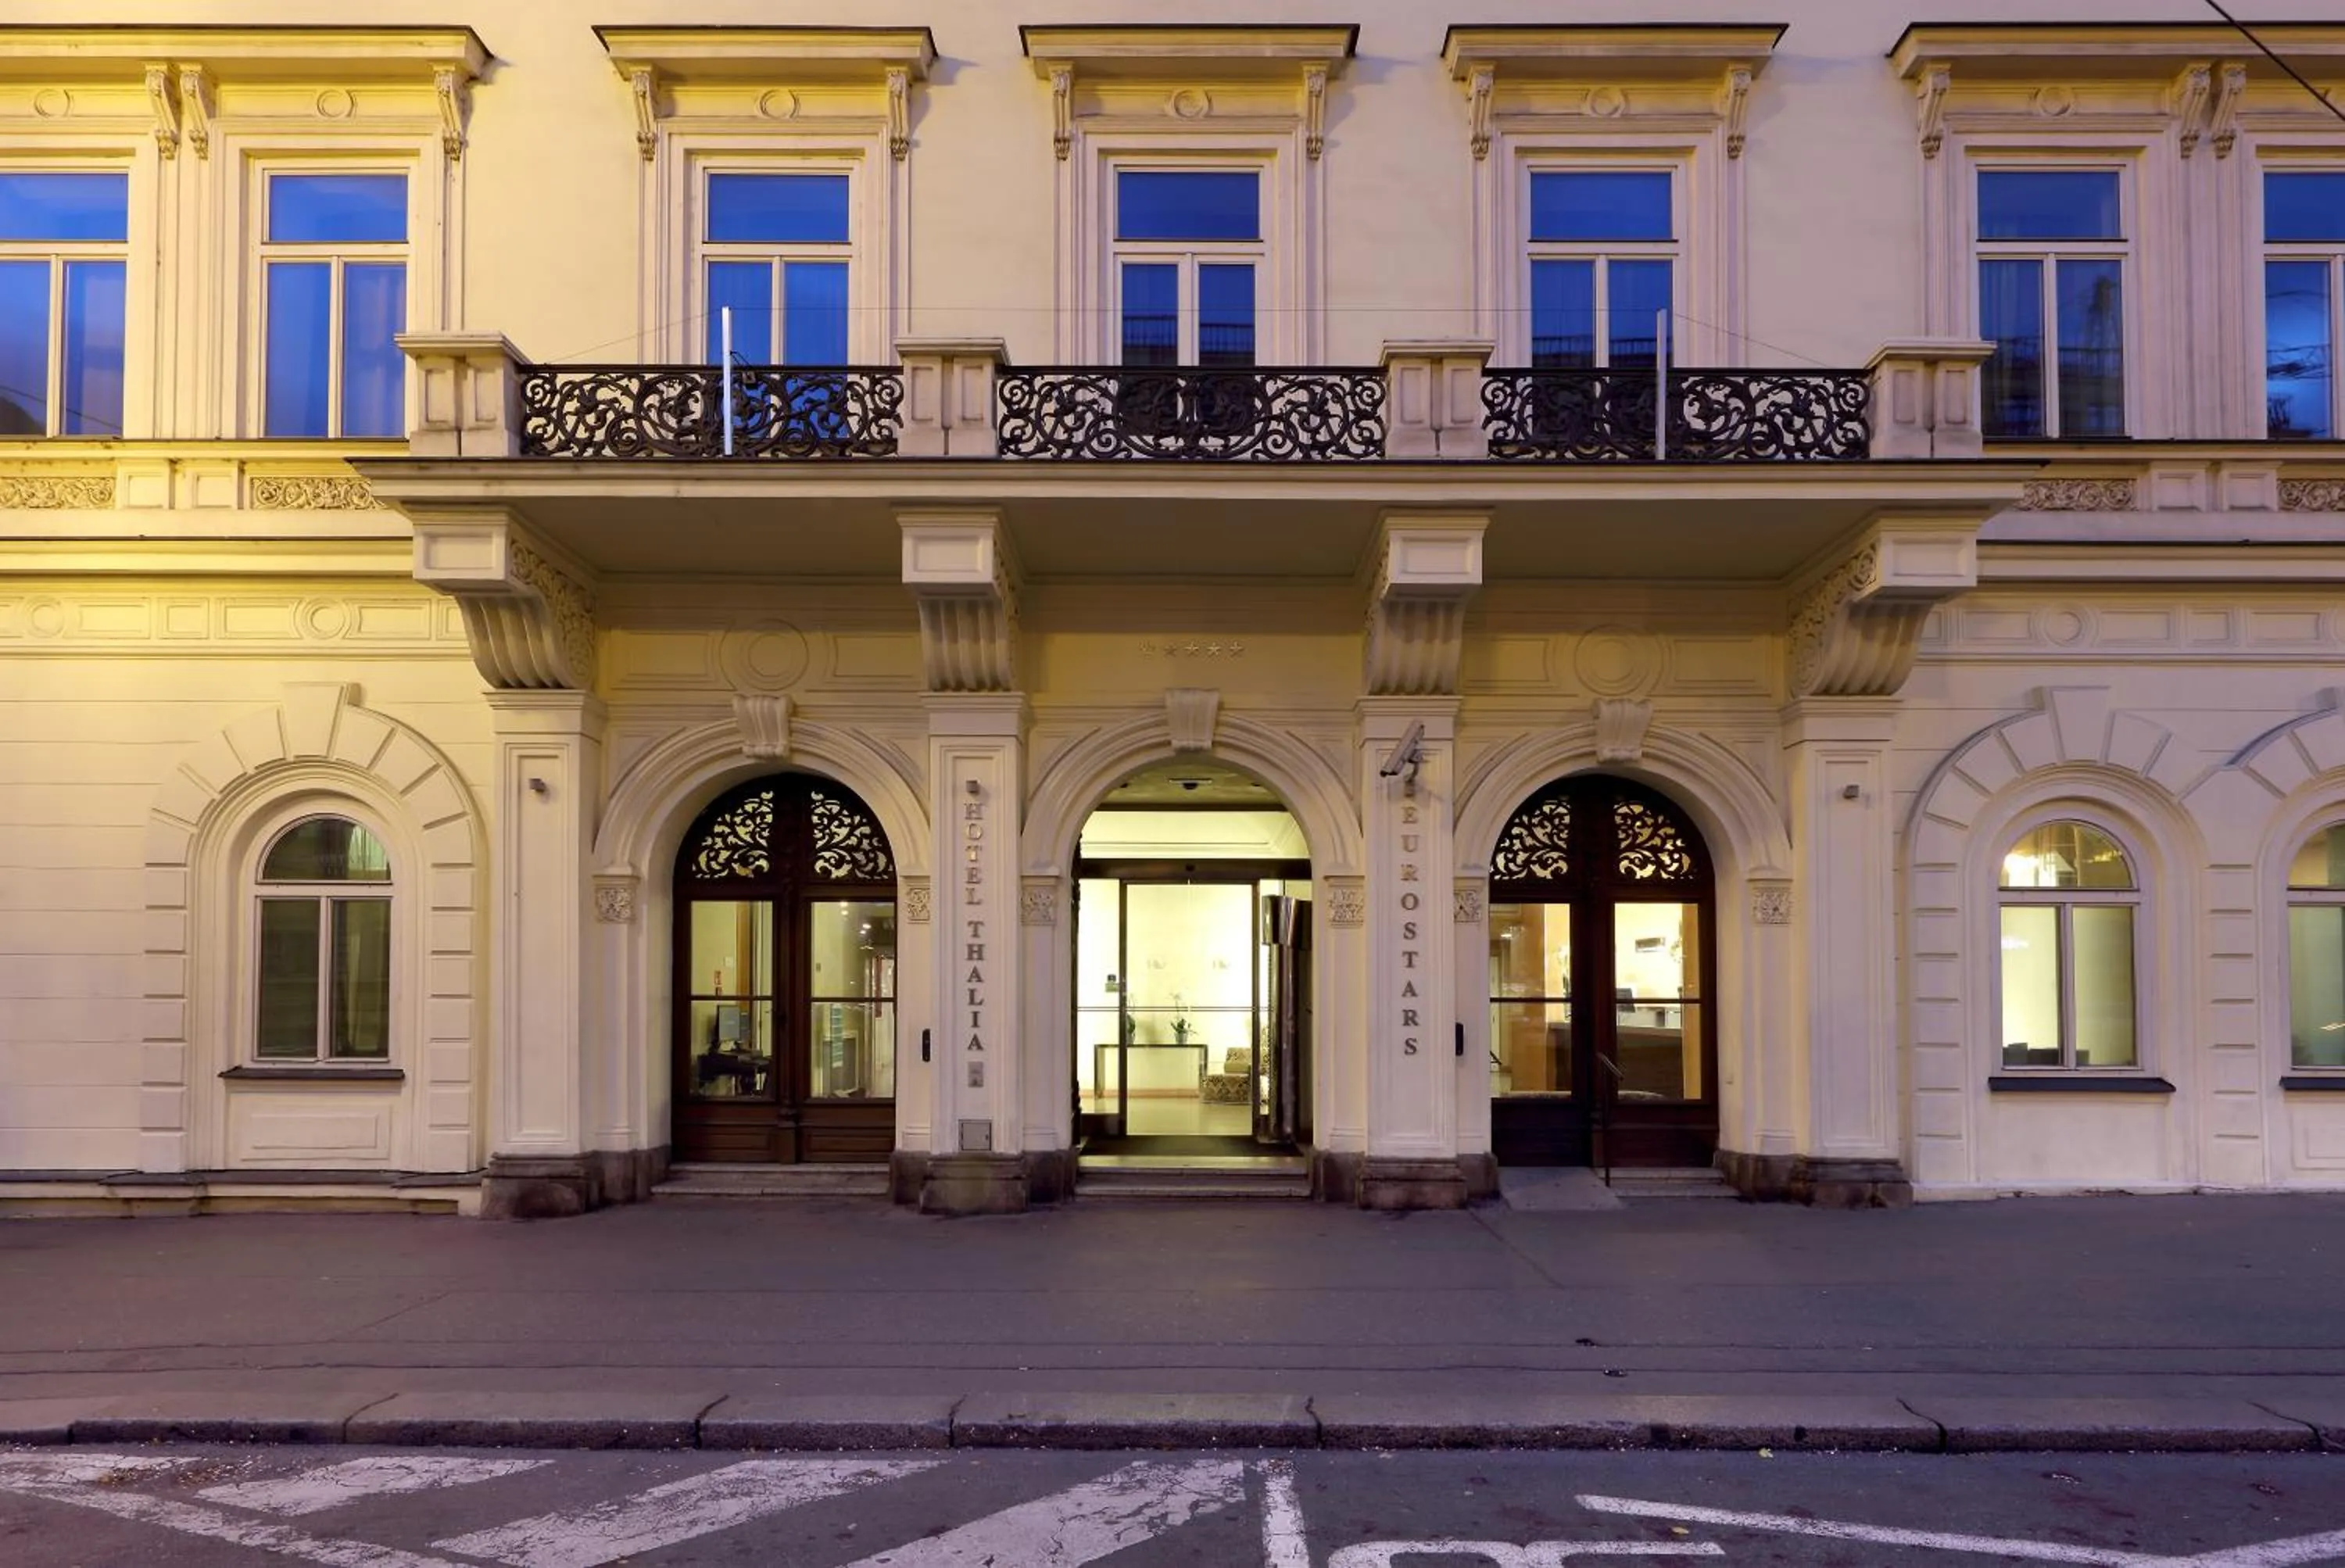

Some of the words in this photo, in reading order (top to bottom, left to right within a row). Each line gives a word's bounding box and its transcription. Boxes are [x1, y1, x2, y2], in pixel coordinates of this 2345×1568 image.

[964, 802, 984, 905] HOTEL
[966, 921, 985, 1051] THALIA
[1401, 806, 1420, 1055] EUROSTARS
